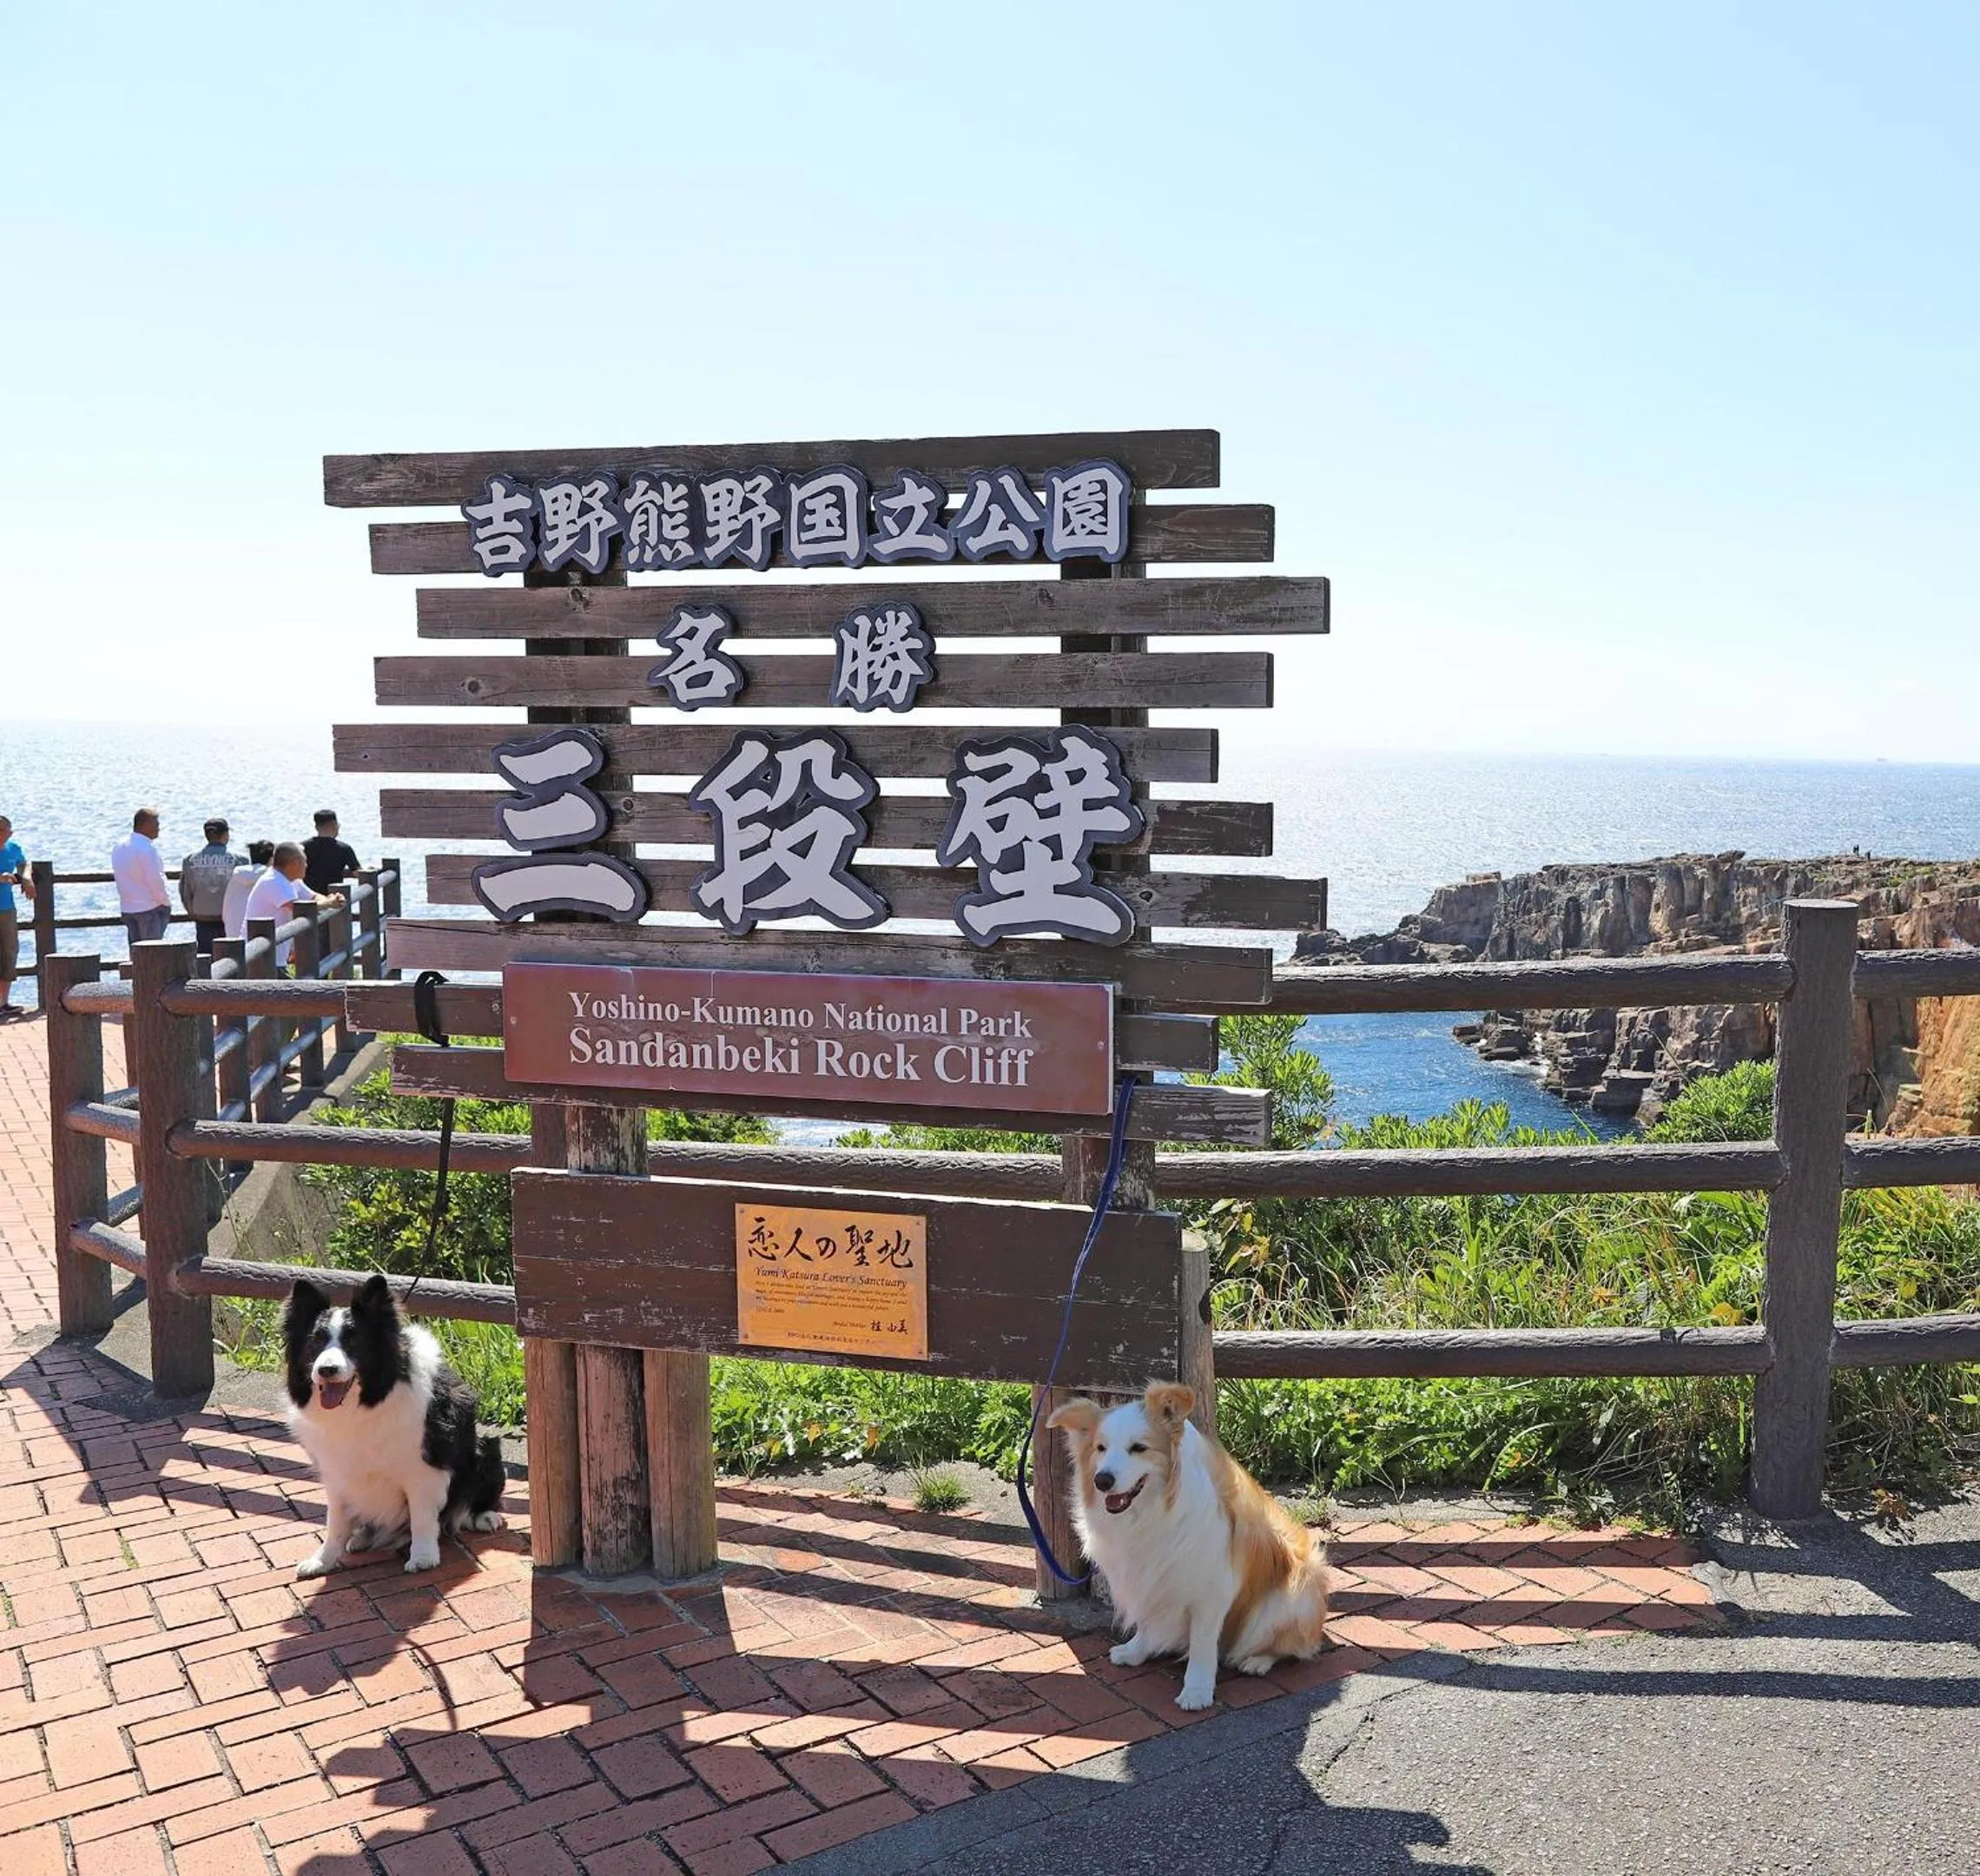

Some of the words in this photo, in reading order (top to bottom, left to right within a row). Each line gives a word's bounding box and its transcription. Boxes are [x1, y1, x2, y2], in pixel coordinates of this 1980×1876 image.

[465, 464, 1131, 571] 吉野熊野国立公園
[657, 609, 927, 707] 名勝
[478, 737, 1133, 937] 三段壁
[567, 991, 815, 1029] Yoshino-Kumano
[823, 1002, 949, 1035] National
[959, 1008, 1033, 1039] Park
[569, 1025, 801, 1075] Sandanbeki
[814, 1039, 922, 1081] Rock
[934, 1045, 1034, 1087] Cliff
[748, 1216, 914, 1269] 恋人の聖地
[857, 1274, 908, 1291] Sanctuary
